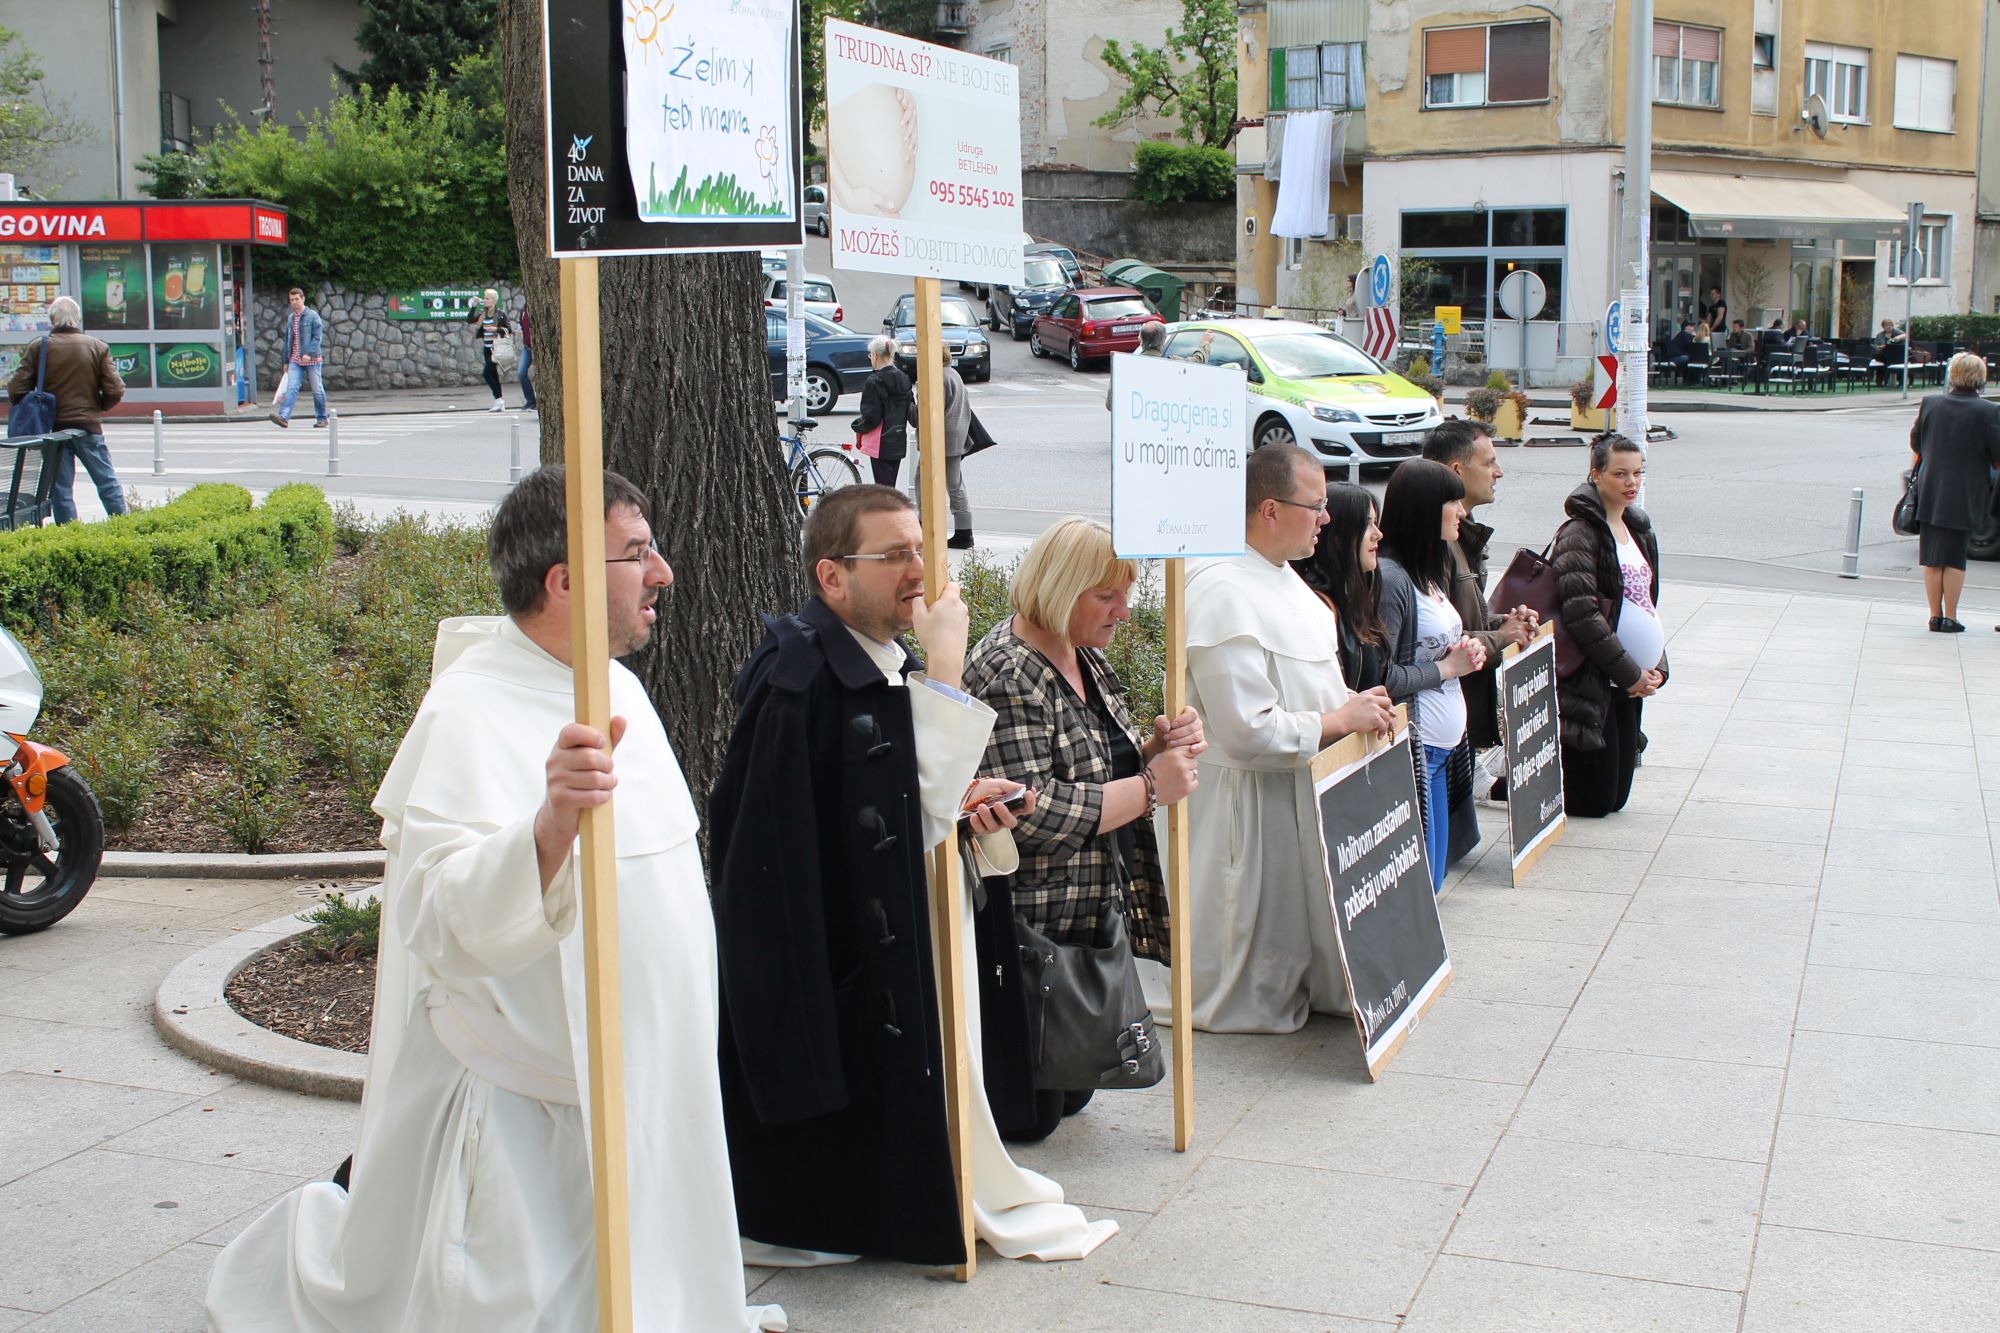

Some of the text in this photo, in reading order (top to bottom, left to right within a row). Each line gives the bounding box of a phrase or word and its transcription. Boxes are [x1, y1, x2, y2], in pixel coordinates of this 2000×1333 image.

[668, 34, 737, 88] Želim
[834, 33, 1010, 97] TRUDNA SI? NE BOJ SE
[661, 93, 751, 136] tebi mama
[567, 141, 587, 164] 40
[957, 140, 984, 158] Udruga
[567, 165, 605, 183] DANA
[957, 158, 999, 177] BETLEHEM
[567, 186, 585, 204] ZA
[929, 179, 1015, 209] 095 5545 102
[258, 215, 283, 238] TRGOVINA
[567, 203, 606, 225] ŽIVOT
[840, 226, 1018, 270] MOŽEŠ DOBITI POMOĆ
[170, 356, 207, 370] Najbolje
[1130, 390, 1232, 434] Dragocjena si
[1124, 437, 1241, 475] u mojim očima.
[1512, 683, 1518, 709] U
[1336, 799, 1411, 875] Molitvom zaustavimo
[1343, 872, 1377, 931] pobačaj
[1372, 874, 1381, 896] u
[1379, 849, 1398, 889] ovoj
